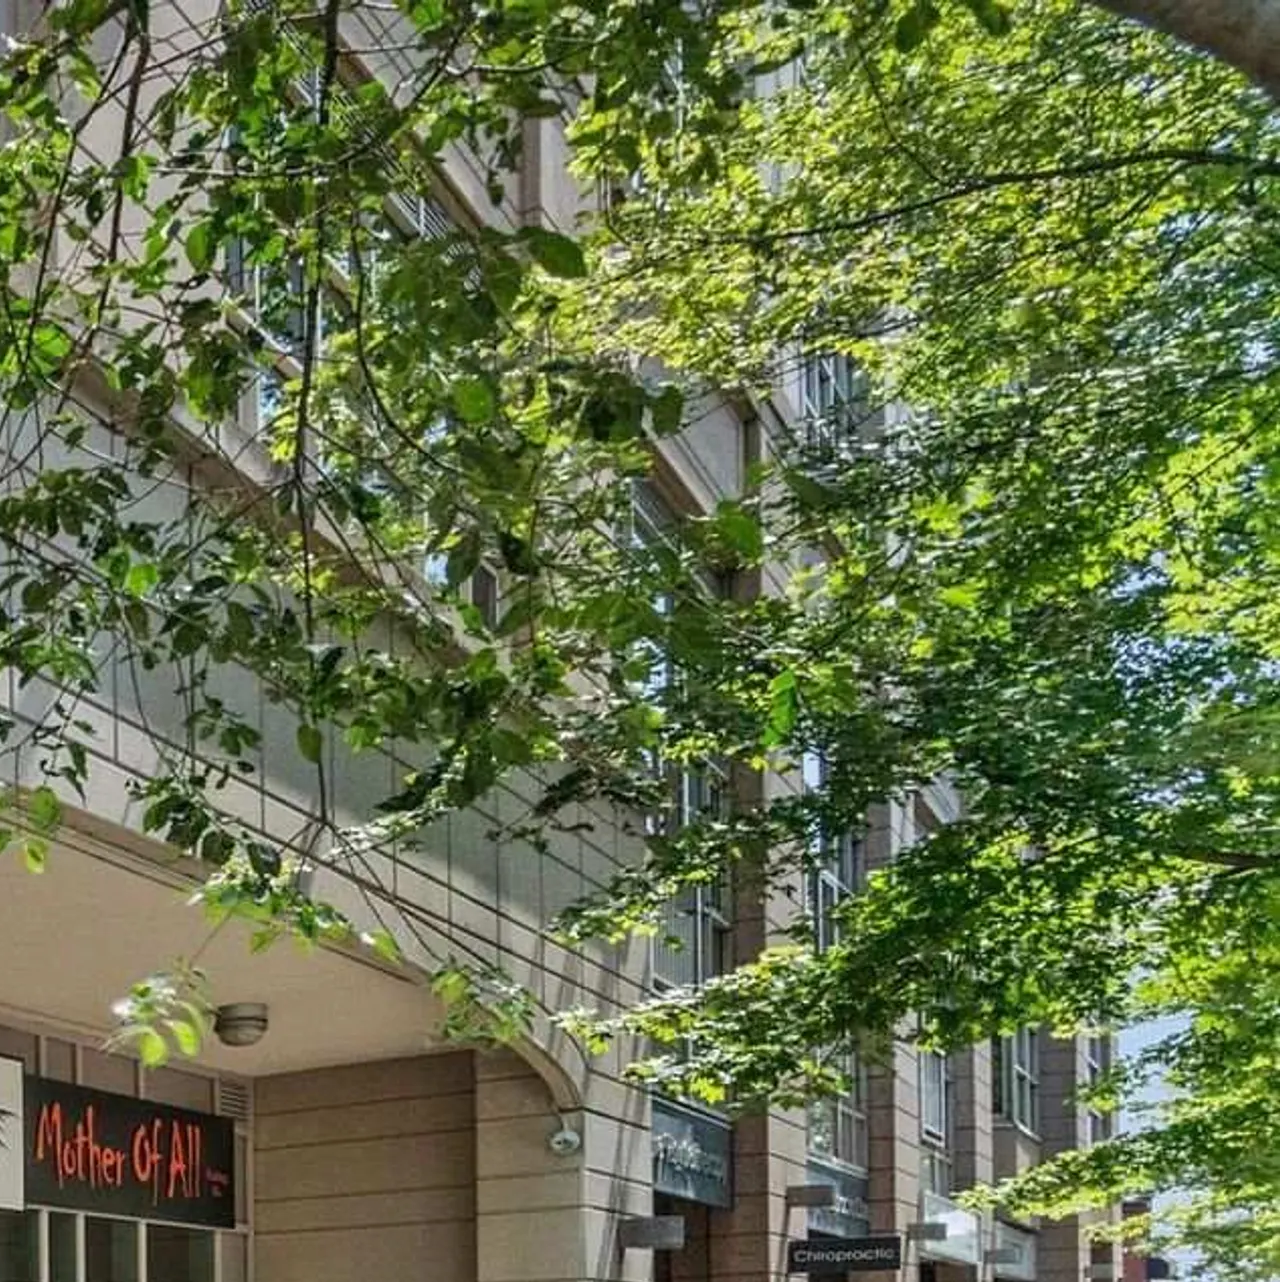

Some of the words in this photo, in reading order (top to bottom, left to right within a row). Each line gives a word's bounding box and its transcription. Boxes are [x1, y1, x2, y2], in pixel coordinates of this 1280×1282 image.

[34, 1101, 125, 1189] Mother
[132, 1117, 164, 1205] Of
[168, 1120, 203, 1198] All
